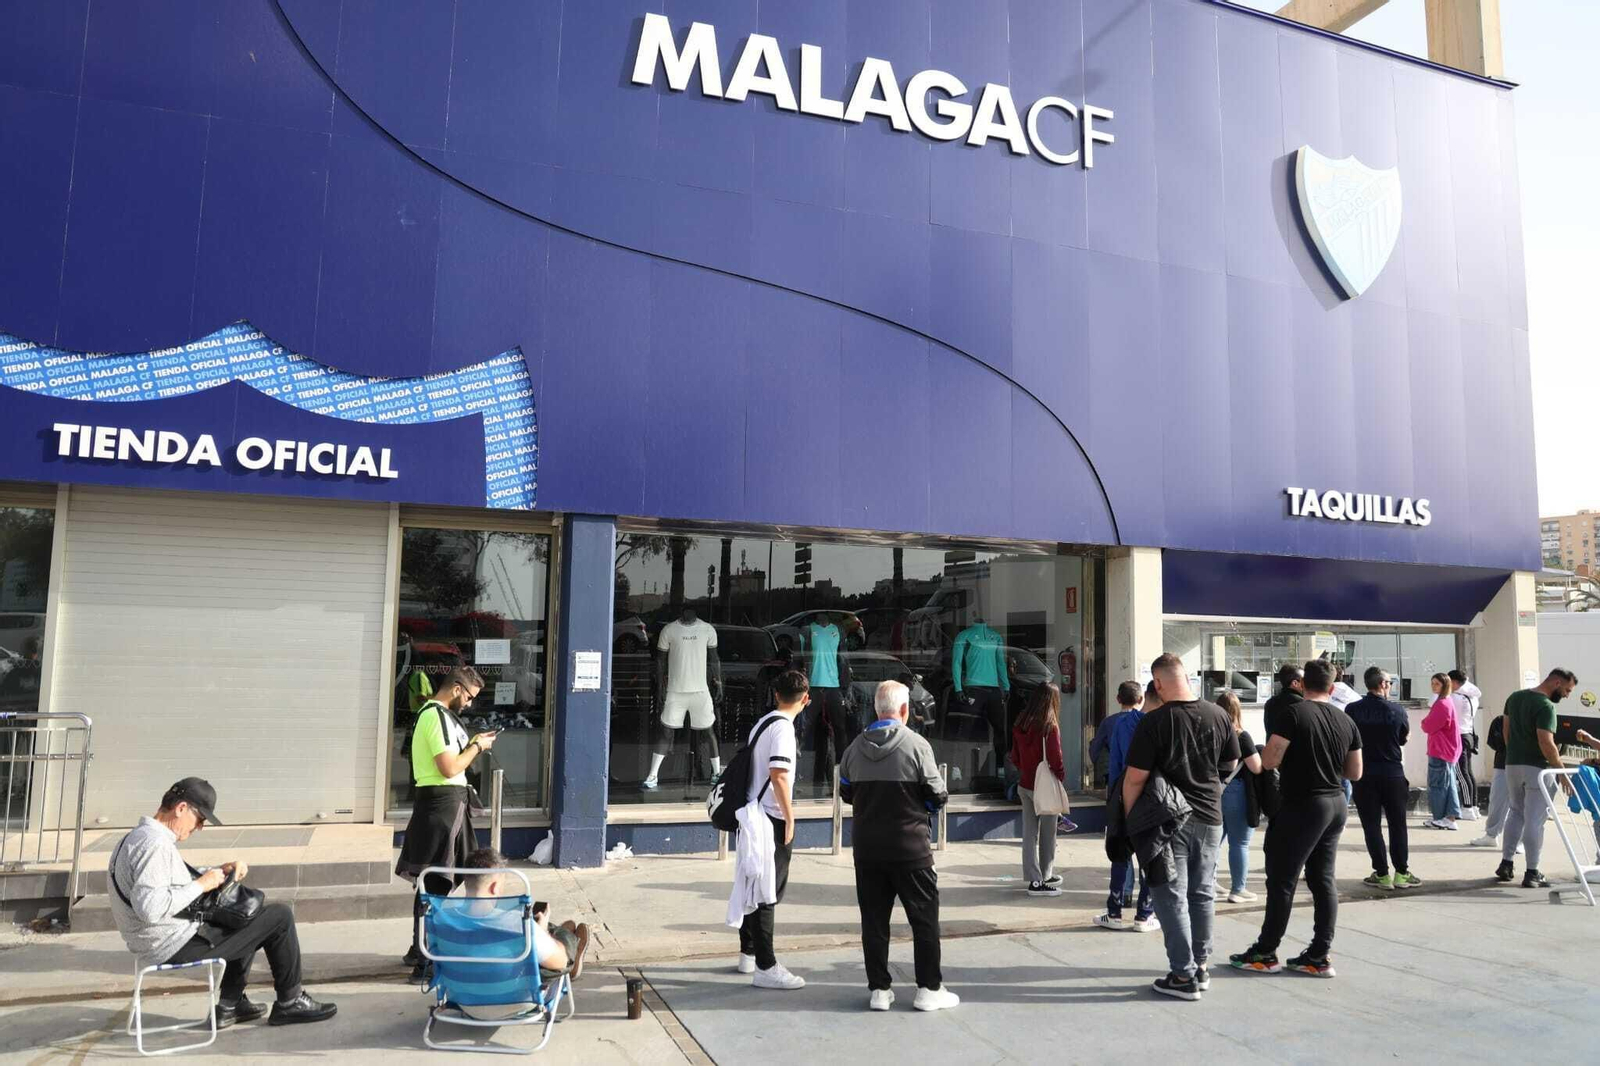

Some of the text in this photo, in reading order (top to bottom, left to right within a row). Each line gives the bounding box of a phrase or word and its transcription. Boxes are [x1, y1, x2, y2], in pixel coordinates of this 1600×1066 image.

[1, 352, 39, 364] TIENDA
[2, 361, 42, 374] TIENDA
[44, 354, 84, 367] OFICIAL
[6, 371, 44, 384] TIENDA
[47, 364, 87, 377] OFICIAL
[88, 356, 133, 370] MALAGA
[149, 346, 184, 359] TIENDA
[186, 339, 223, 352] OFICIAL
[49, 373, 89, 387] OFICIAL
[91, 365, 135, 380] MALAGA
[137, 362, 149, 371] CF
[151, 356, 187, 369] TIENDA
[188, 349, 225, 361] OFICIAL
[52, 383, 91, 396] OFICIAL
[93, 375, 137, 389] MALAGA
[140, 372, 151, 381] CF
[153, 365, 189, 378] TIENDA
[191, 358, 228, 371] OFICIAL
[230, 350, 271, 364] MALAGA
[272, 347, 284, 356] CF
[96, 385, 140, 399] MALAGA
[142, 381, 154, 390] CF
[156, 375, 191, 387] TIENDA
[194, 368, 231, 380] OFICIAL
[232, 359, 273, 373] MALAGA
[275, 356, 286, 365] CF
[144, 391, 156, 400] CF
[157, 384, 194, 397] TIENDA
[277, 366, 288, 375] CF
[280, 375, 290, 383] CF
[292, 368, 326, 381] TIENDA
[282, 384, 293, 393] CF
[294, 377, 328, 390] TIENDA
[297, 386, 331, 399] TIENDA
[332, 379, 367, 392] OFICIAL
[300, 396, 333, 409] TIENDA
[335, 388, 369, 401] OFICIAL
[337, 398, 372, 411] OFICIAL
[373, 389, 412, 403] MALAGA
[413, 385, 424, 394] CF
[425, 378, 457, 391] TIENDA
[458, 370, 491, 383] OFICIAL
[376, 398, 414, 412] MALAGA
[416, 395, 426, 403] CF
[427, 387, 459, 400] TIENDA
[461, 379, 493, 393] OFICIAL
[378, 407, 417, 421] MALAGA
[418, 403, 429, 412] CF
[430, 396, 462, 409] TIENDA
[463, 388, 495, 401] OFICIAL
[421, 412, 431, 420] CF
[432, 405, 464, 418] TIENDA
[466, 397, 498, 410] OFICIAL
[53, 423, 399, 479] TIENDA OFICIAL
[486, 468, 518, 481] OFICIAL
[489, 477, 521, 490] OFICIAL
[491, 486, 523, 499] OFICIAL
[1287, 487, 1432, 526] TAQUILLAS
